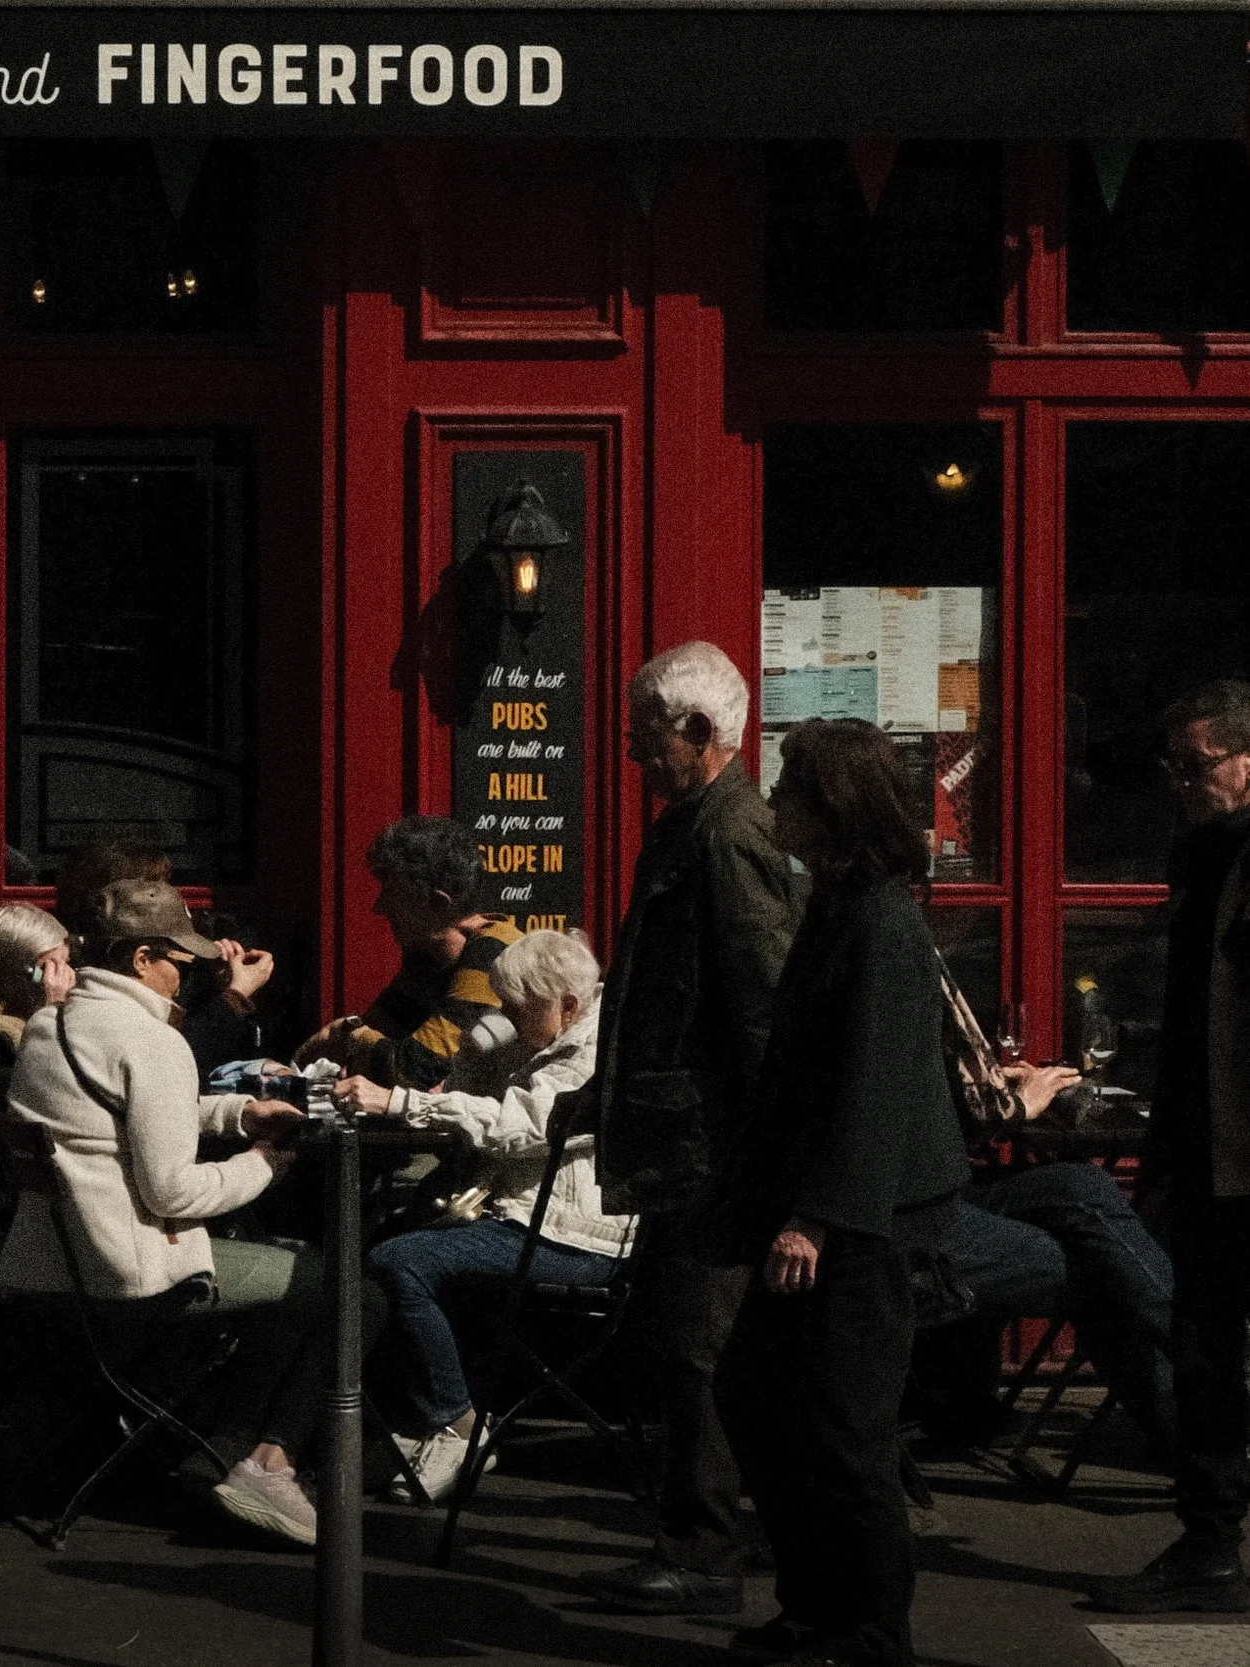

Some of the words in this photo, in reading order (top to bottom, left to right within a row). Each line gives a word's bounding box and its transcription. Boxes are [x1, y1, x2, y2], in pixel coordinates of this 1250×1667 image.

[98, 44, 562, 106] FINGERFOOD
[507, 666, 530, 689] the
[534, 669, 567, 689] best
[492, 702, 547, 731] PUBS
[477, 742, 505, 759] are
[507, 740, 541, 759] built
[544, 743, 565, 760] on
[488, 772, 502, 801] A
[506, 773, 548, 801] HILL
[475, 814, 497, 832] so
[501, 815, 531, 837] you
[535, 814, 565, 832] can
[543, 844, 564, 873] IN
[500, 882, 534, 902] and
